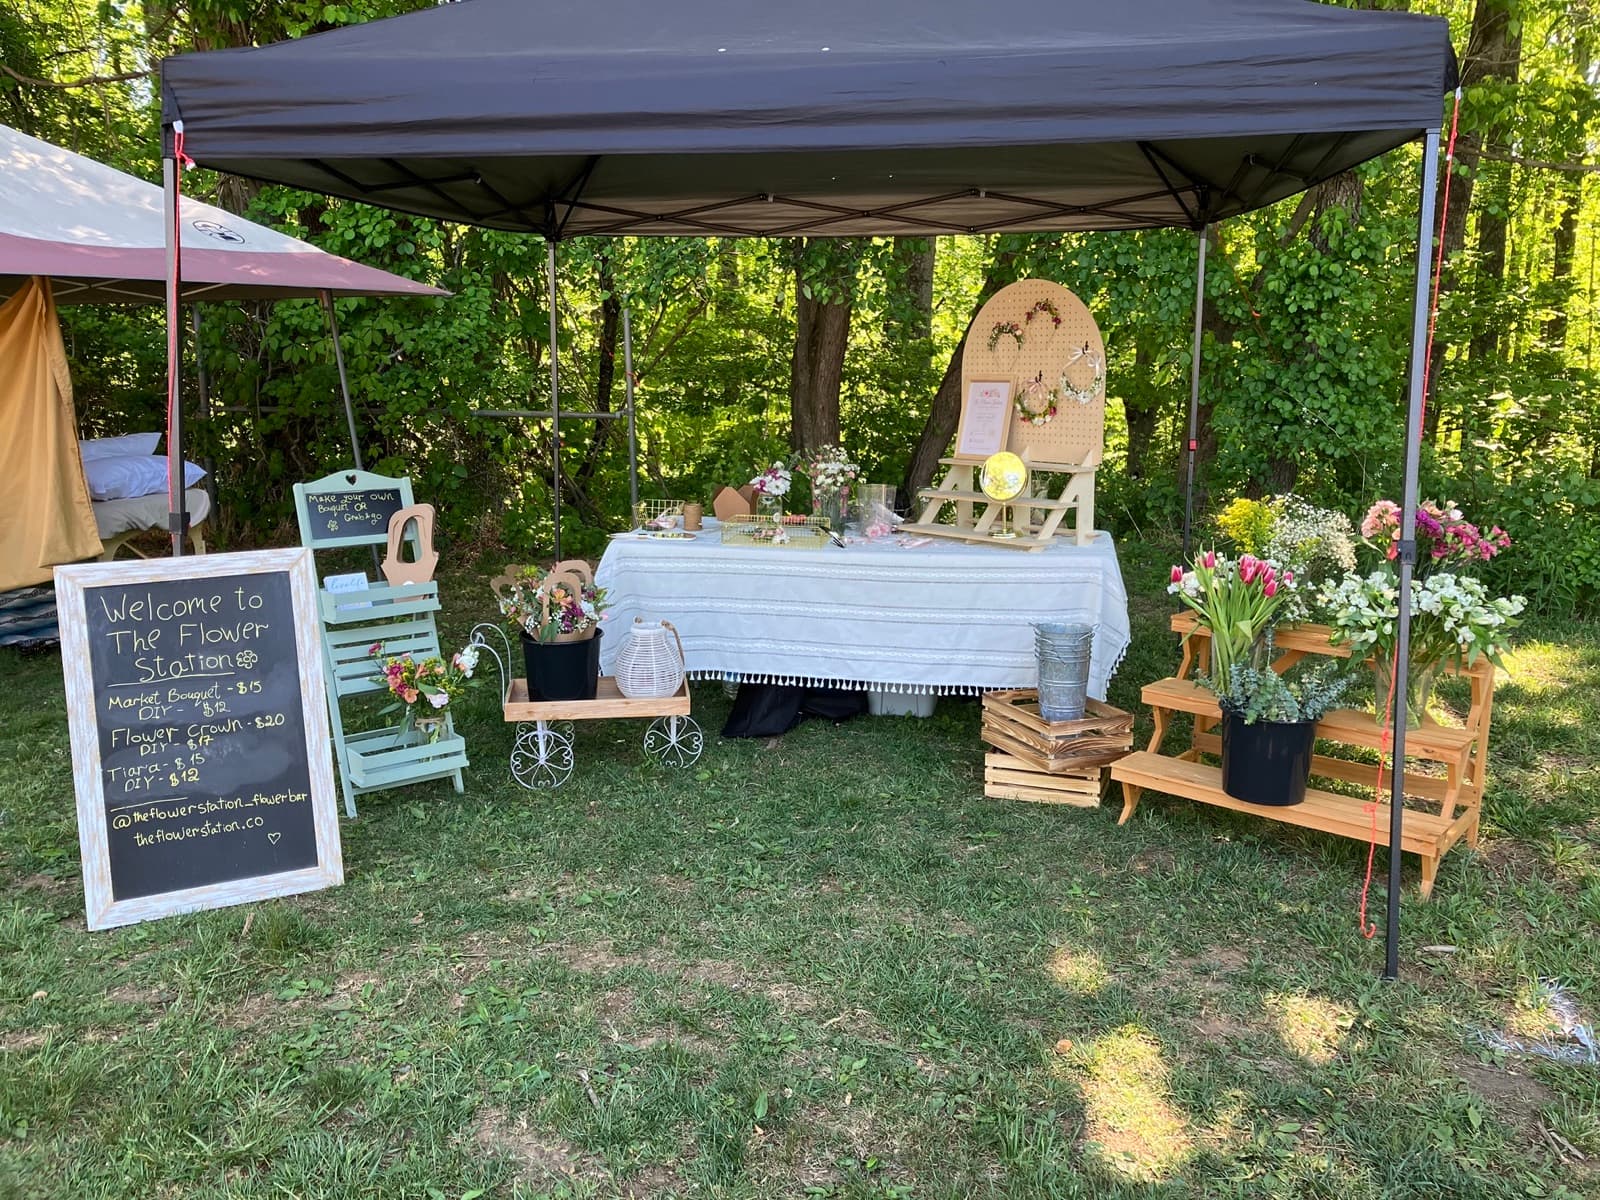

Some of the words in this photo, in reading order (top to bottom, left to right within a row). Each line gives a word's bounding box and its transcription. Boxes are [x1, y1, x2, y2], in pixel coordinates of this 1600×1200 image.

[308, 494, 337, 503] Make
[341, 494, 364, 504] your
[100, 592, 223, 623] Welcome
[234, 586, 263, 611] to
[106, 627, 161, 655] The
[179, 621, 269, 647] Flower
[134, 652, 234, 683] Station
[108, 692, 161, 710] Market
[168, 682, 221, 707] Bouquet
[138, 704, 173, 721] DIY
[202, 701, 231, 718] $12
[112, 726, 179, 748] Flower
[187, 718, 243, 738] Crown
[140, 740, 168, 757] DIY
[186, 735, 214, 750] $17
[124, 776, 155, 792] DIY
[169, 767, 201, 787] $12
